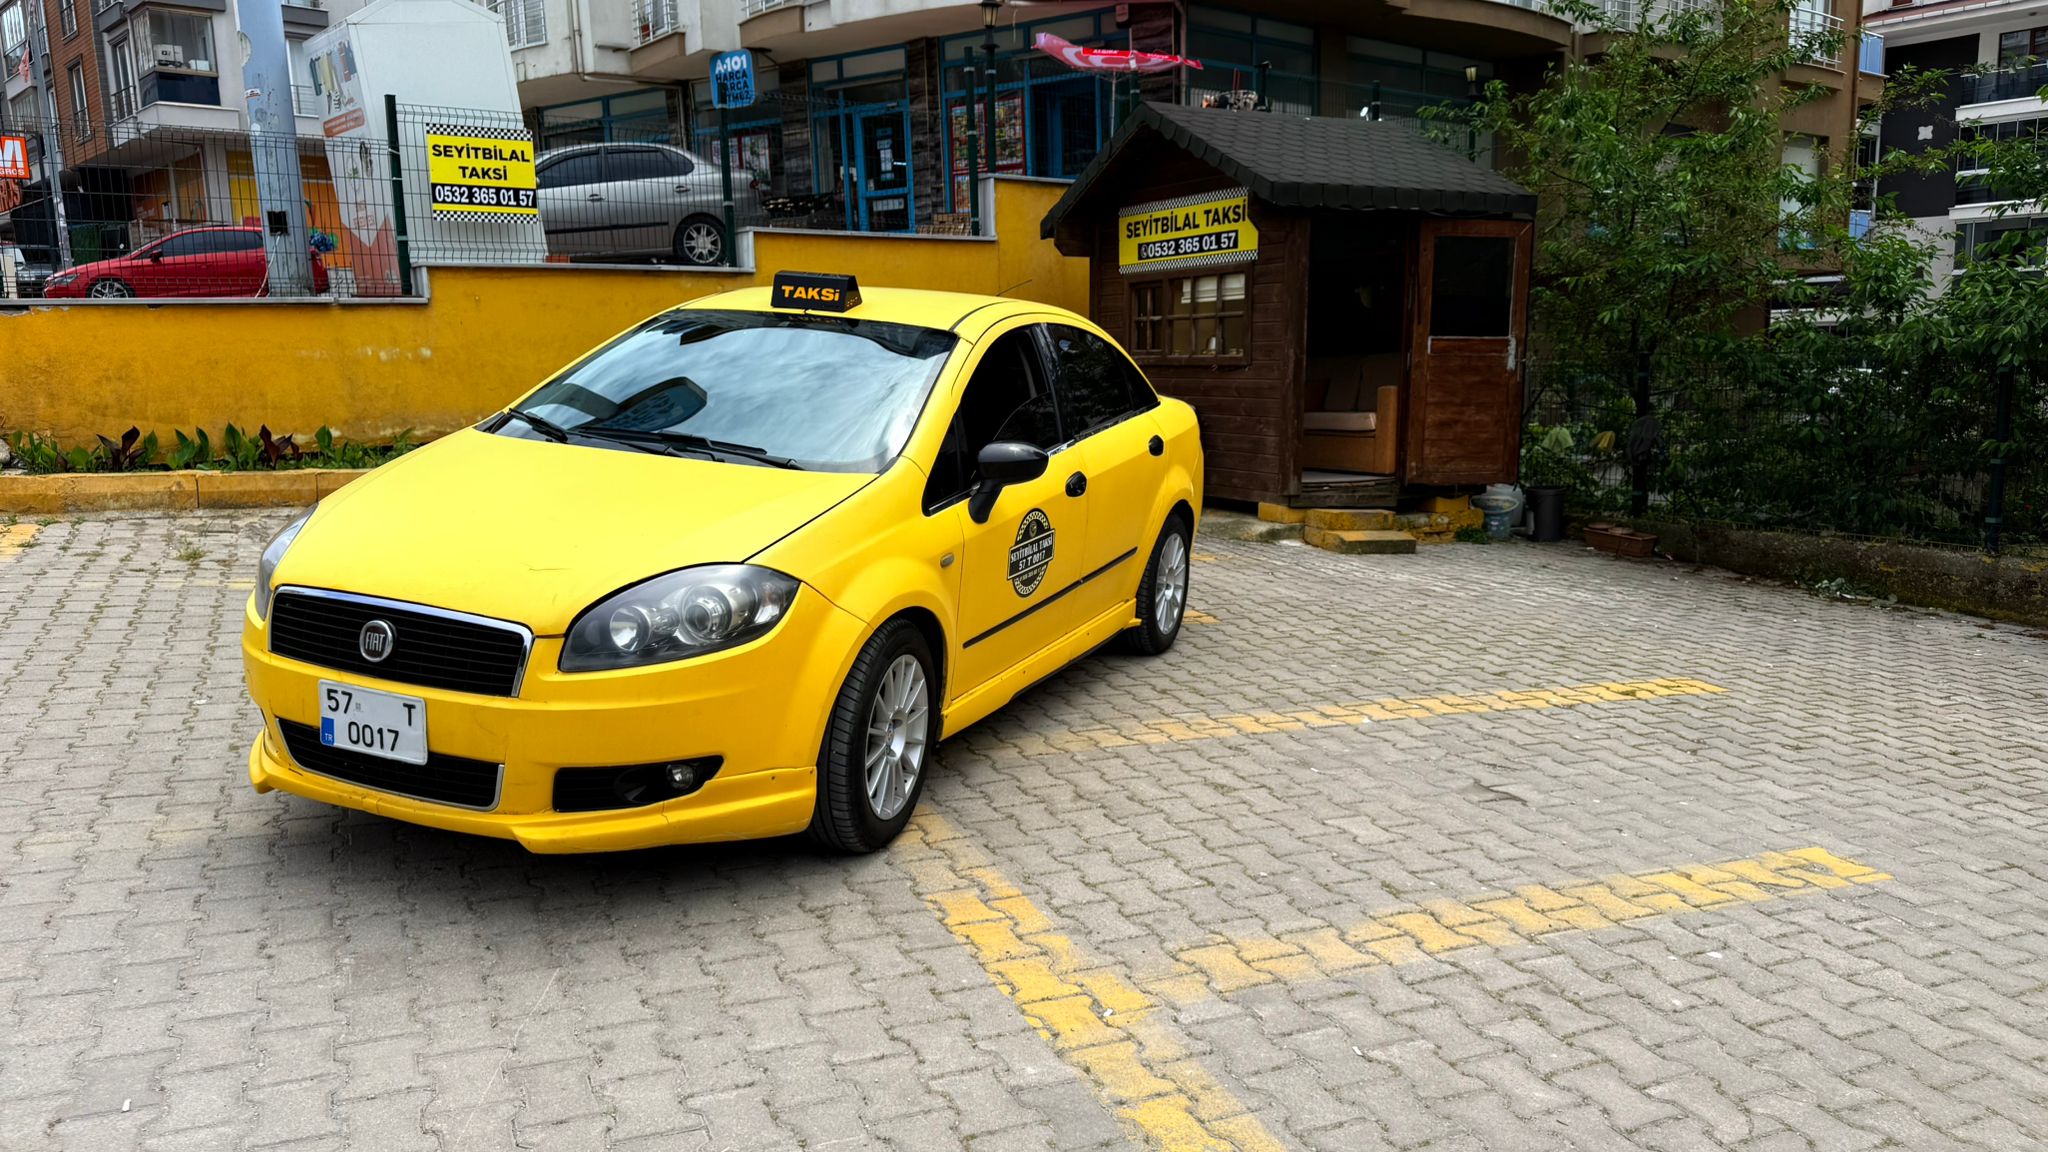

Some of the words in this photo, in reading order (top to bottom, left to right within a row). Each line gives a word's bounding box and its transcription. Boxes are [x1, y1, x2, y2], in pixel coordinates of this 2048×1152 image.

[432, 143, 530, 162] SEYİTBİLAL
[458, 165, 507, 180] TAKSİ
[435, 185, 469, 203] 0532
[472, 187, 496, 204] 365
[500, 189, 516, 205] 01
[519, 190, 534, 207] 57
[1126, 211, 1199, 239] SEYİTBİLAL
[1204, 199, 1246, 227] TAKSİ
[1148, 240, 1175, 258] 0532
[1178, 237, 1200, 254] 365
[1202, 235, 1218, 251] 01
[1220, 232, 1236, 248] 57
[365, 632, 385, 651] FIAT
[326, 688, 353, 714] 57
[402, 702, 416, 727] T
[324, 733, 333, 742] TR
[348, 721, 399, 751] 0017
